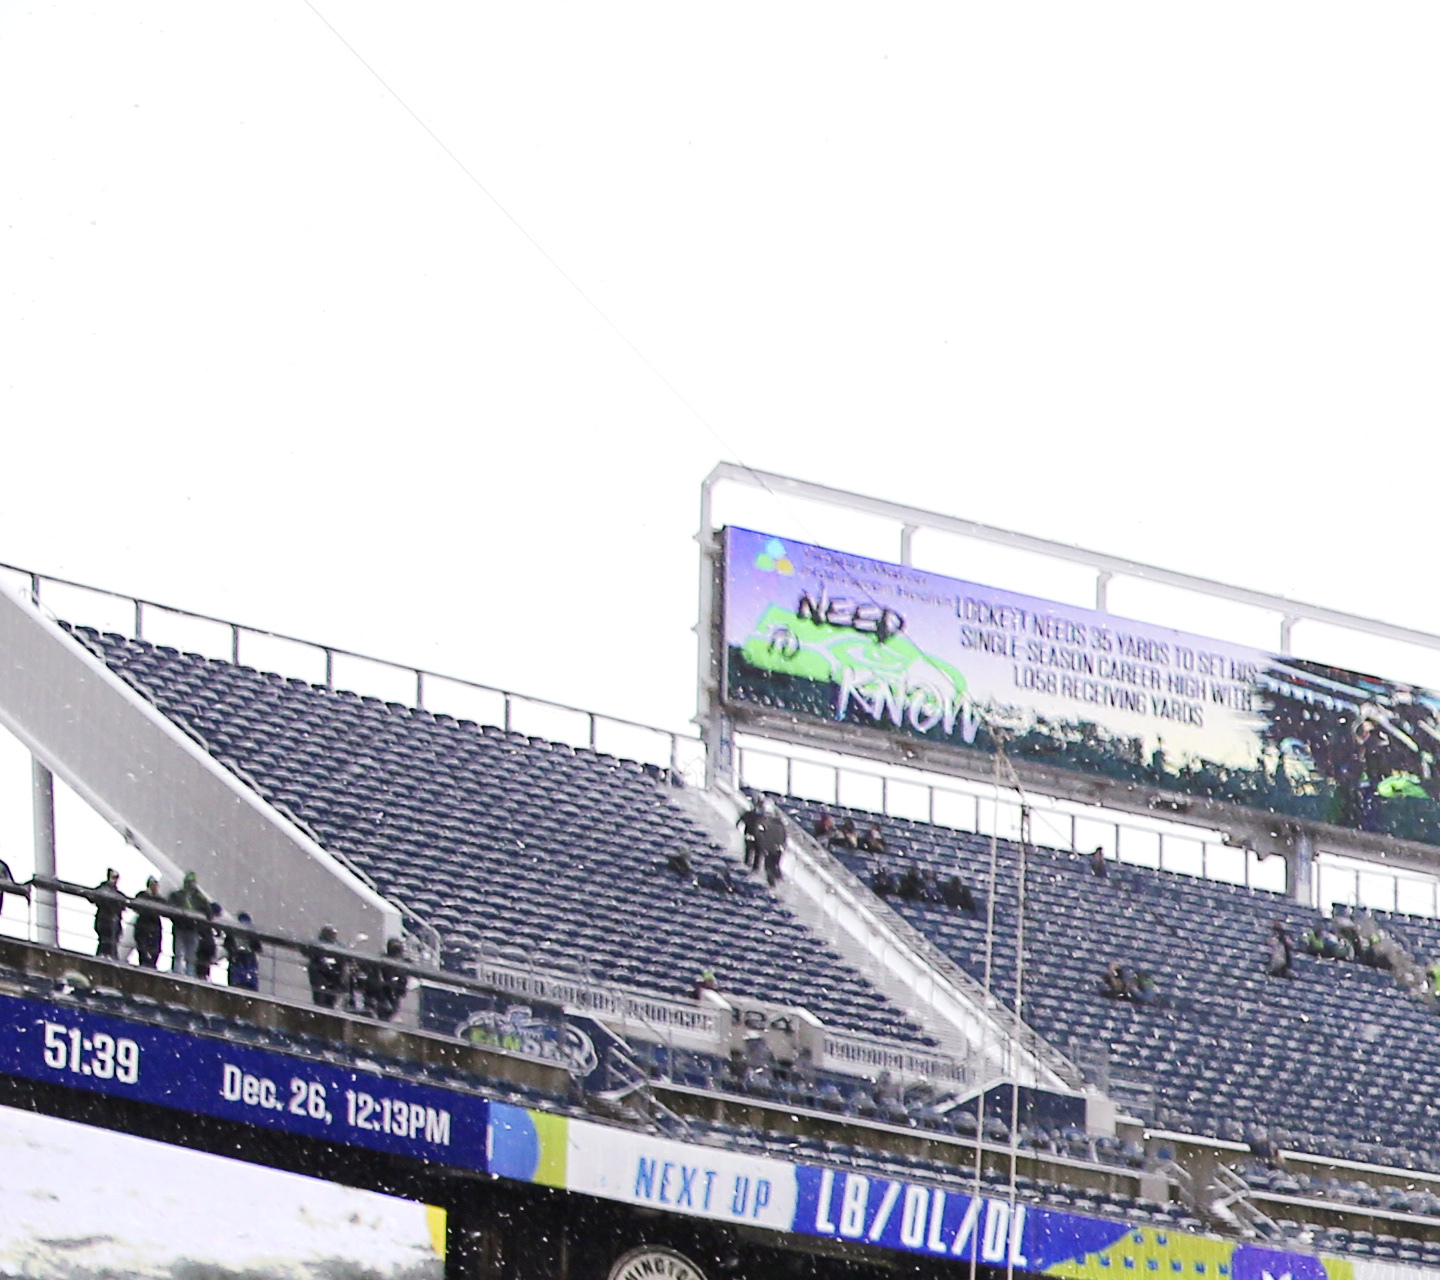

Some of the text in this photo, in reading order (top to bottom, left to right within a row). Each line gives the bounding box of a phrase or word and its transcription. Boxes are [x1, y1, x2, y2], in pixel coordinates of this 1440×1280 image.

[796, 582, 907, 645] NEED
[955, 596, 1028, 634] LOCKETT
[1034, 614, 1087, 650] NEEDS
[1090, 625, 1113, 652] 35
[1116, 631, 1171, 668] YARDS
[1174, 646, 1196, 672] TO
[1199, 651, 1227, 680] SET
[836, 664, 985, 746] KNOW
[1063, 675, 1148, 716] RECEIVING
[1151, 696, 1205, 729] YARDS
[43, 1024, 452, 1147] 51:39 Dec. 26, 12:13PM
[635, 1156, 1030, 1270] NEXT UP LB/OL/DL
